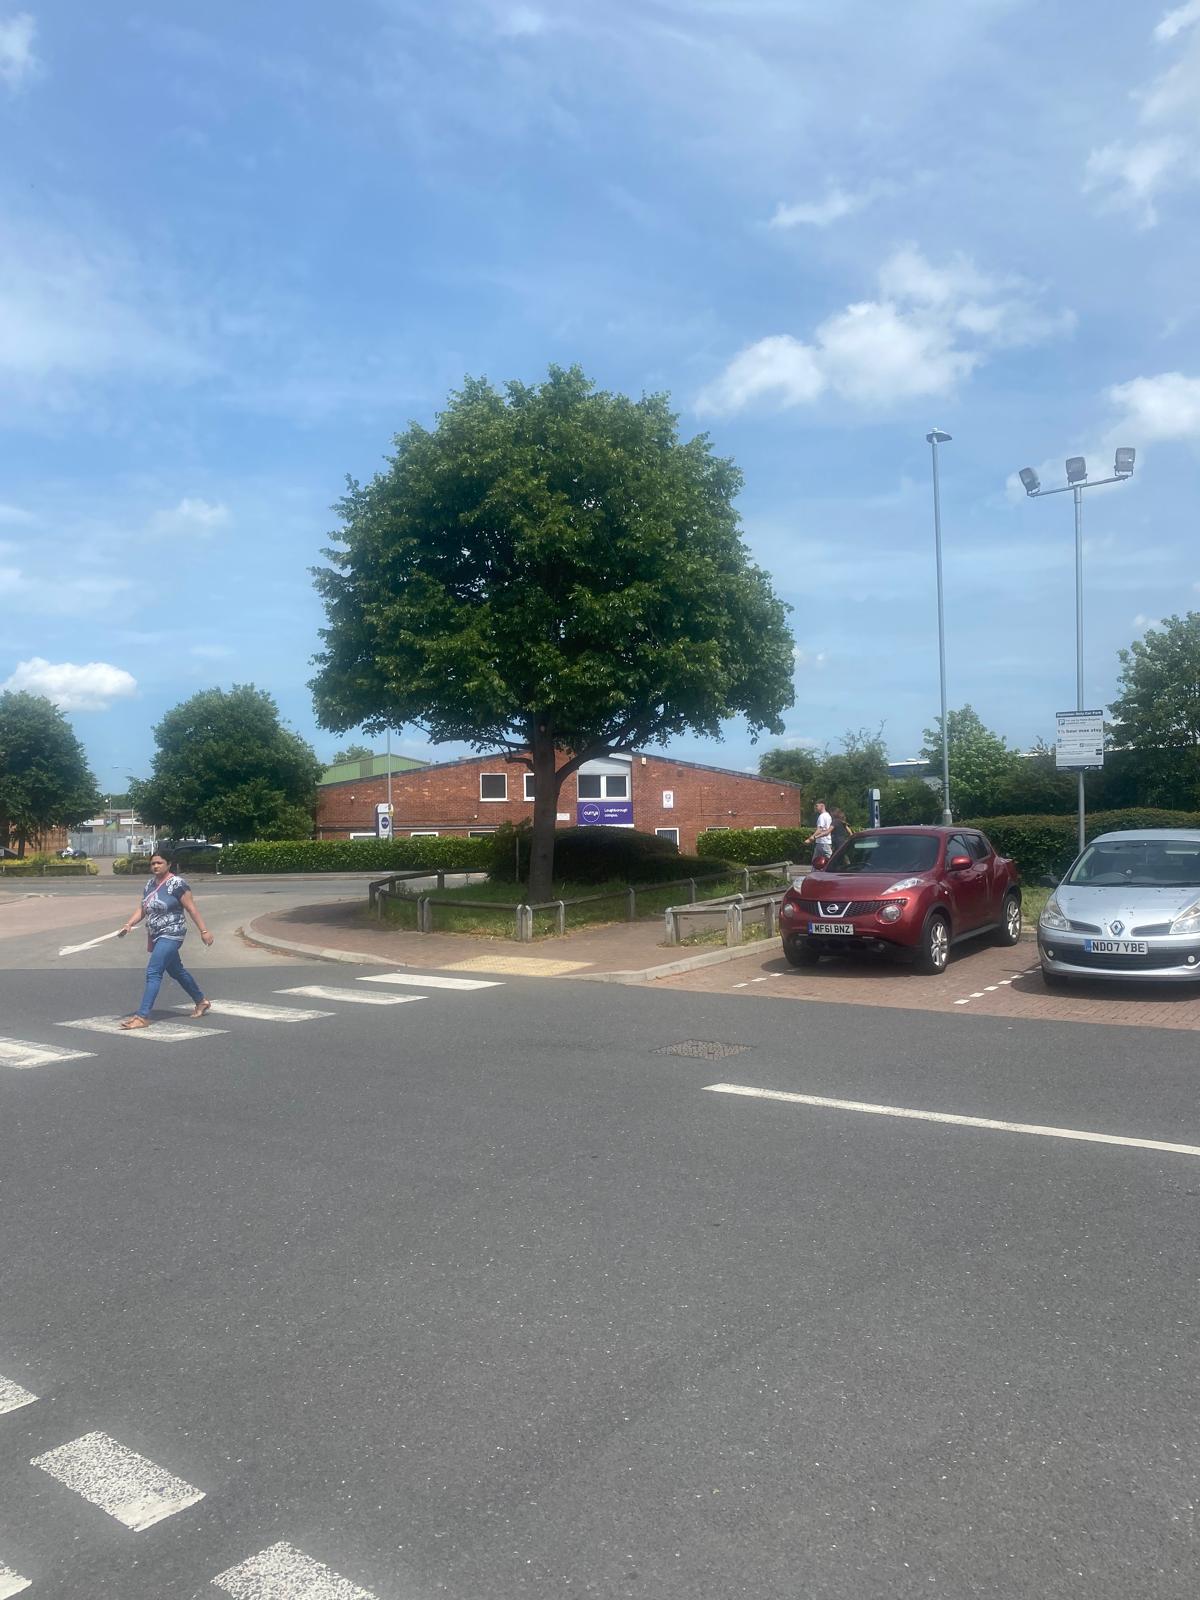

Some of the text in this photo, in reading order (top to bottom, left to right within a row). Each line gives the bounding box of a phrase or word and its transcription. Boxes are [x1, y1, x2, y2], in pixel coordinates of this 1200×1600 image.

[814, 924, 850, 933] MF61 BNZ
[1092, 941, 1145, 953] ND07 YBE
